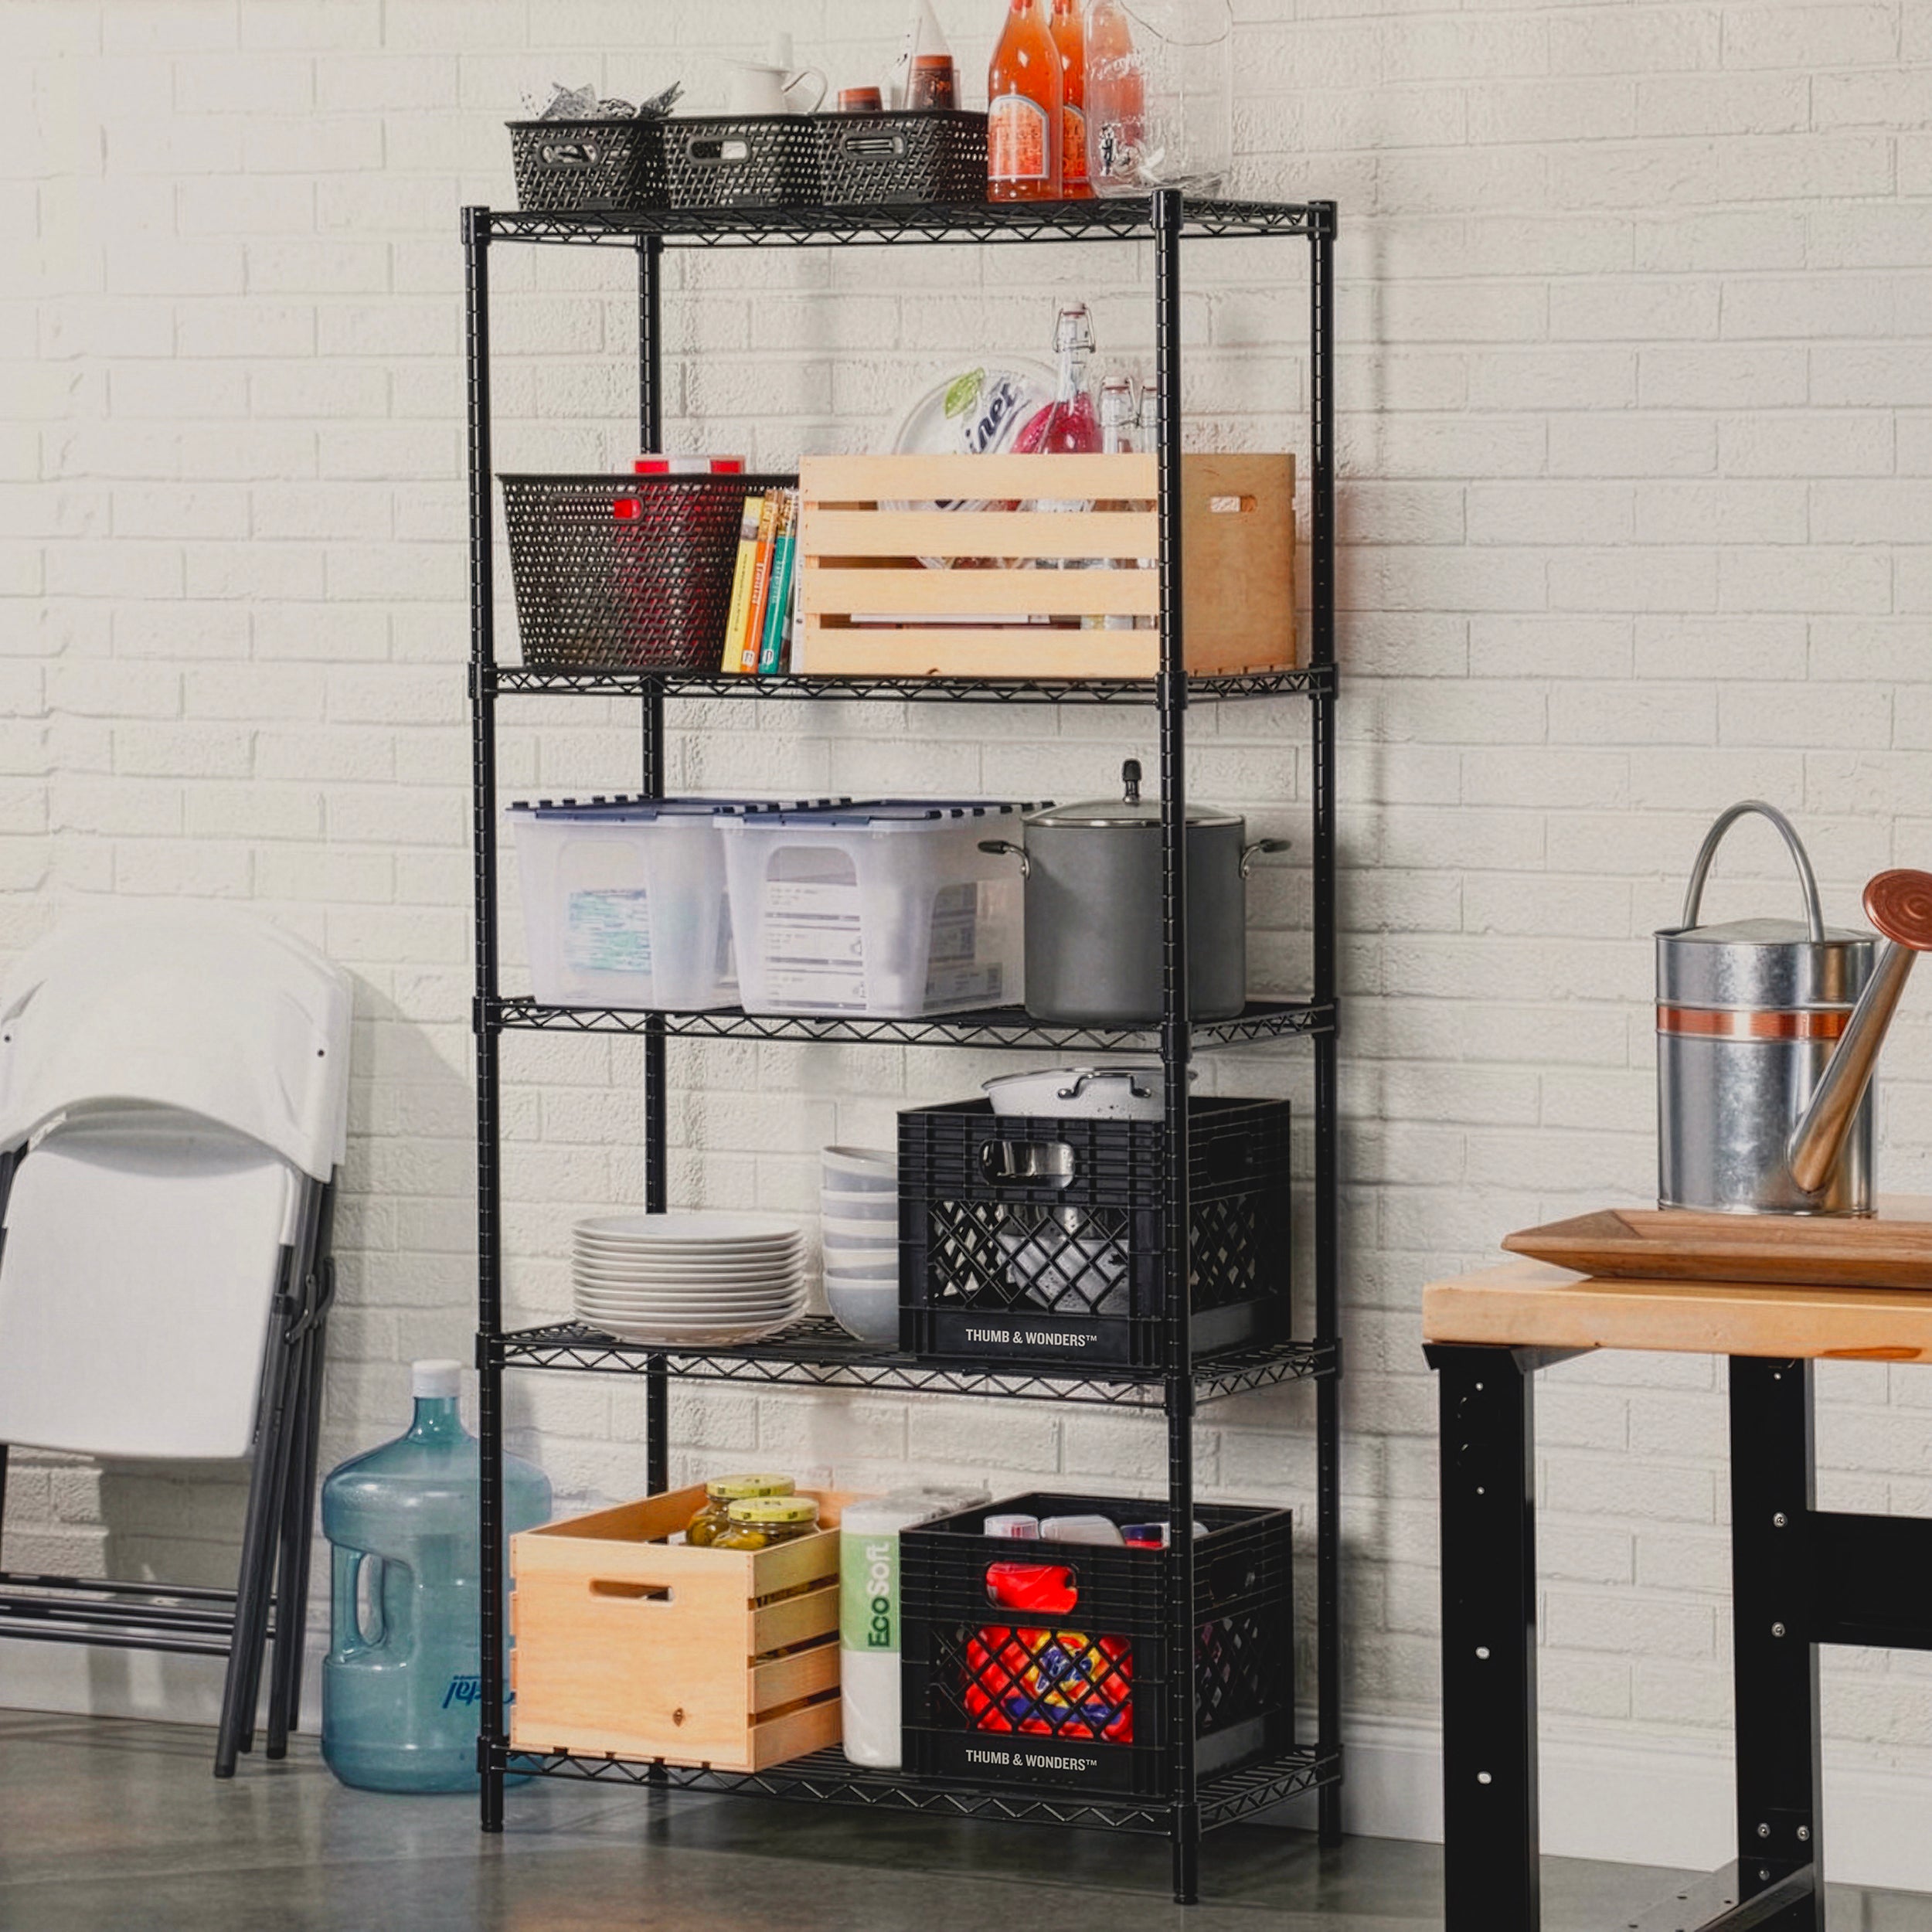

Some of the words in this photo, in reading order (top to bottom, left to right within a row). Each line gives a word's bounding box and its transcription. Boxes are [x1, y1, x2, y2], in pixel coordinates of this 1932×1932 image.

[965, 1328, 1010, 1343] THUMB
[1012, 1331, 1023, 1344] &
[965, 1750, 1010, 1765] THUMB
[1012, 1753, 1023, 1767] &
